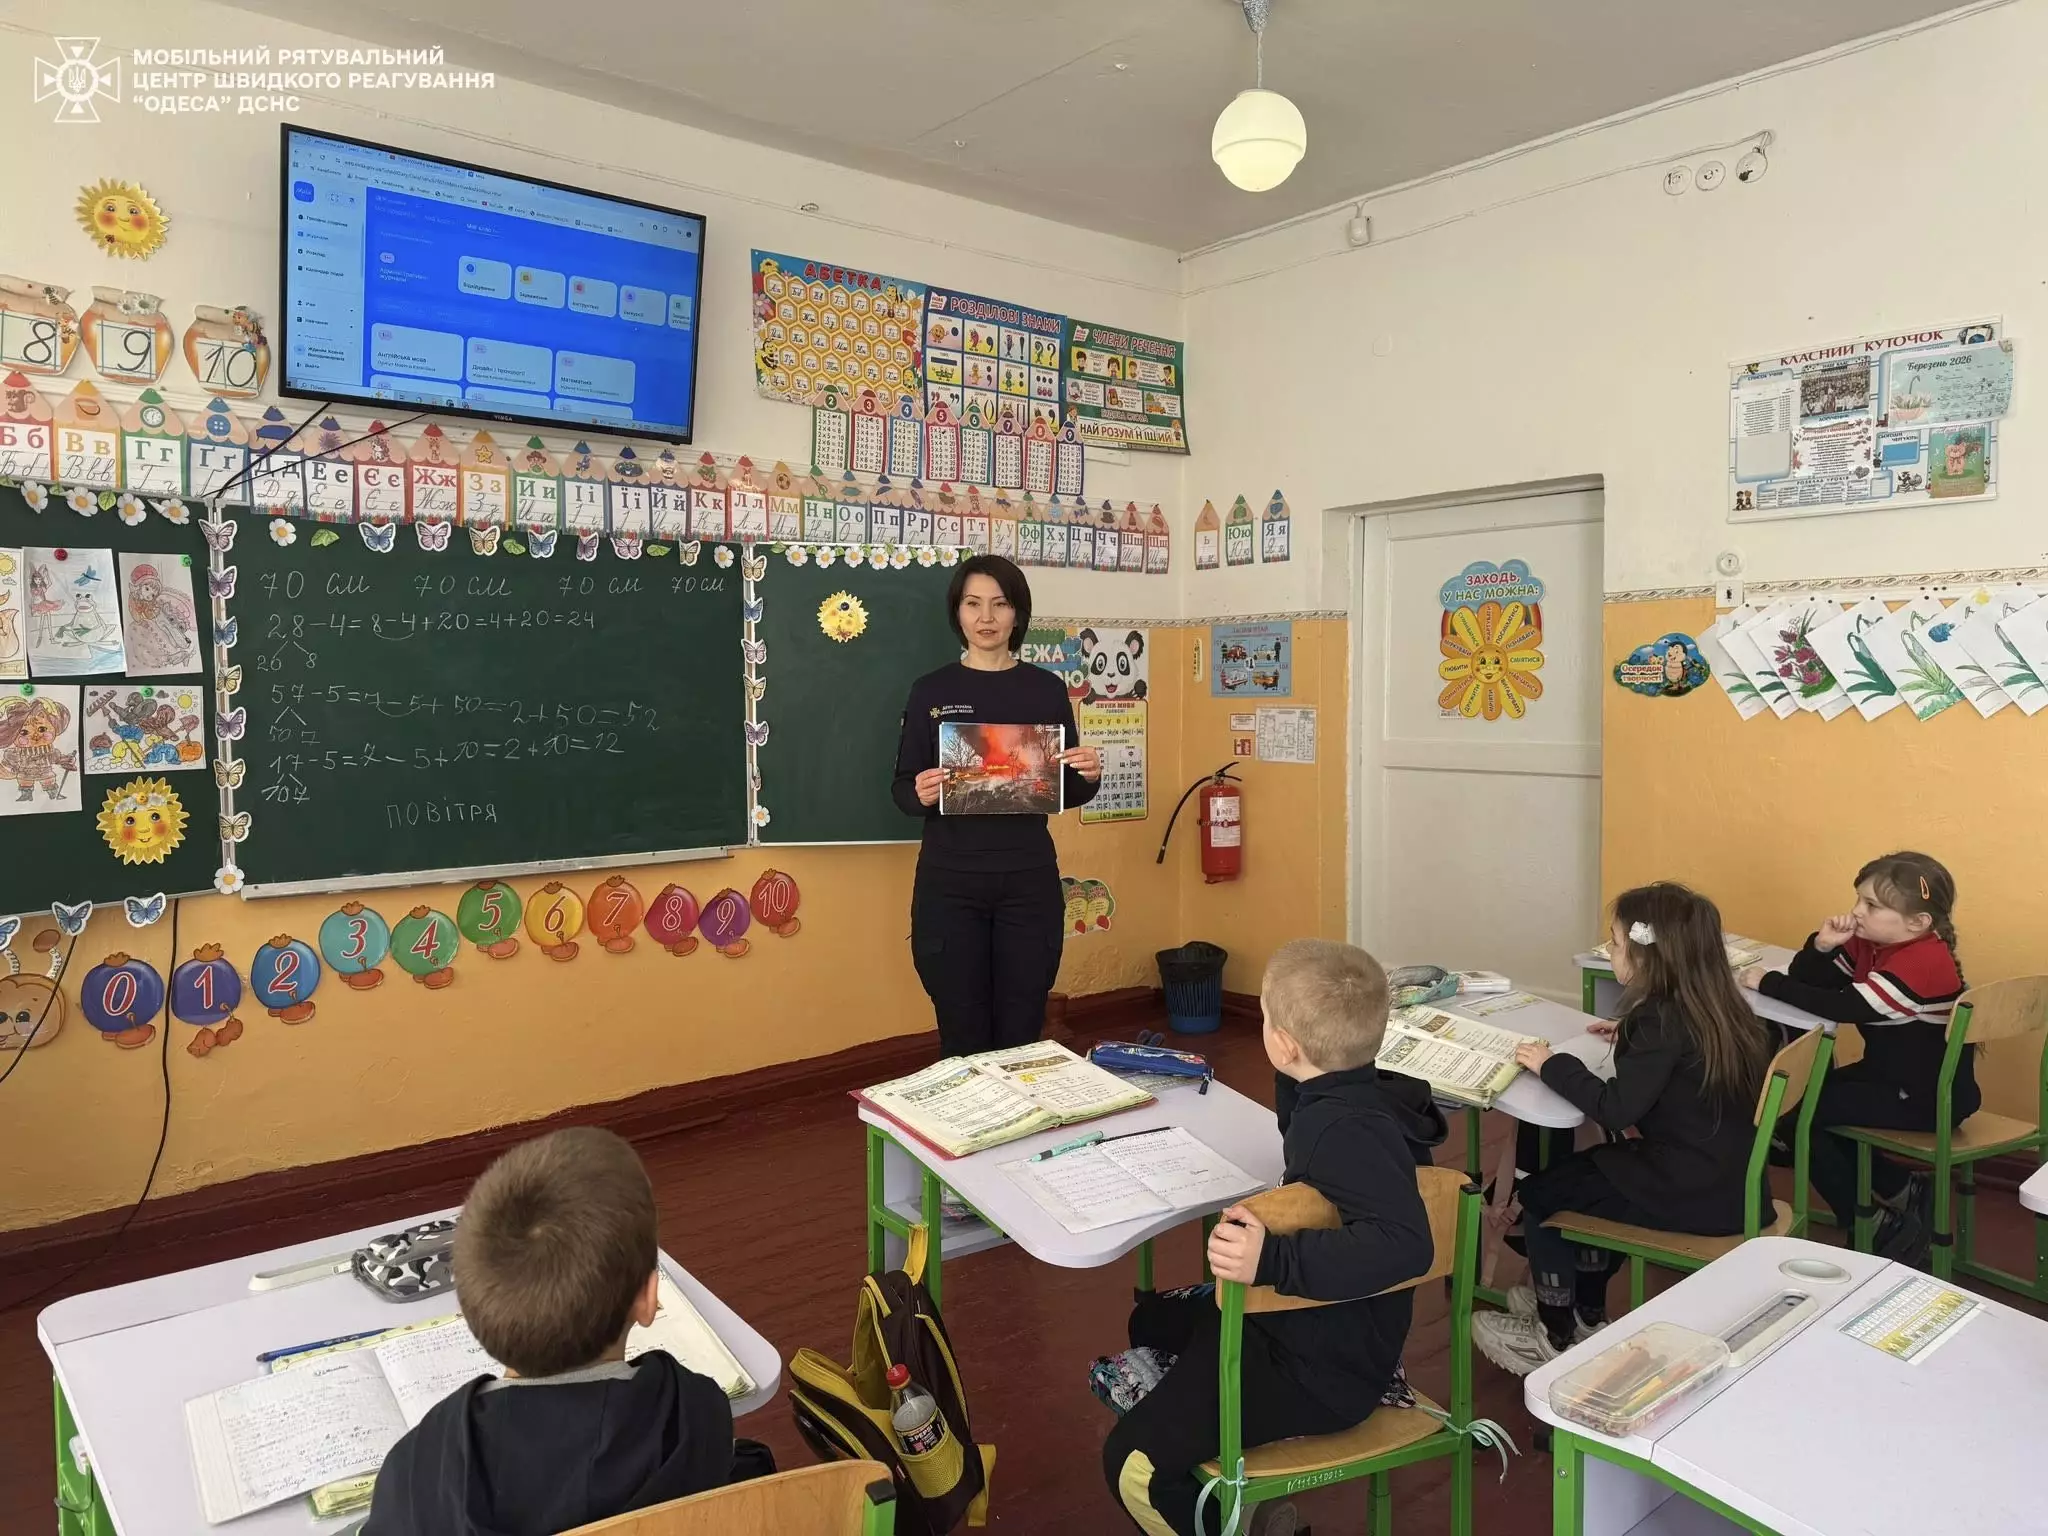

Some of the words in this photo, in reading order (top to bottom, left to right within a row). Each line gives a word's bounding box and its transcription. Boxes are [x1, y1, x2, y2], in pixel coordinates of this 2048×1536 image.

[804, 262, 882, 291] АБЕТКА
[950, 296, 1020, 325] РОЗДІЛОВІ
[1021, 312, 1062, 333] ЗНАКИ
[23, 321, 57, 364] 8
[117, 329, 152, 372] 9
[1092, 328, 1130, 350] ЧЛЕНИ
[1130, 336, 1177, 359] РЕЧЕННЯ
[1864, 330, 1944, 352] КУТОЧОК
[204, 346, 258, 388] 10
[1907, 360, 1948, 373] Березень
[1949, 355, 1973, 366] 2026
[828, 396, 834, 406] 2
[866, 401, 872, 410] 3
[939, 412, 945, 420] 5
[1080, 422, 1100, 435] НАЙ
[1101, 426, 1133, 440] РОЗУМ
[259, 571, 304, 599] 70
[414, 575, 456, 598] 70
[558, 576, 594, 597] 70
[671, 576, 697, 594] 70
[1443, 590, 1452, 602] У
[1456, 589, 1481, 601] НАС
[1484, 585, 1539, 600] МОЖНА:
[1466, 571, 1521, 586] ЗАХОДЬ,
[1622, 664, 1662, 673] Осередок
[386, 797, 497, 829] ПОВІТРЯ
[478, 891, 503, 931] 5
[544, 895, 567, 933] 6
[602, 891, 630, 926] 7
[661, 895, 683, 931] 8
[758, 879, 791, 918] 10
[715, 898, 736, 936] 9
[340, 918, 369, 959] 3
[411, 919, 440, 959] 4
[194, 965, 214, 1010] 1
[268, 950, 300, 994] 2
[102, 971, 137, 1016] 0
